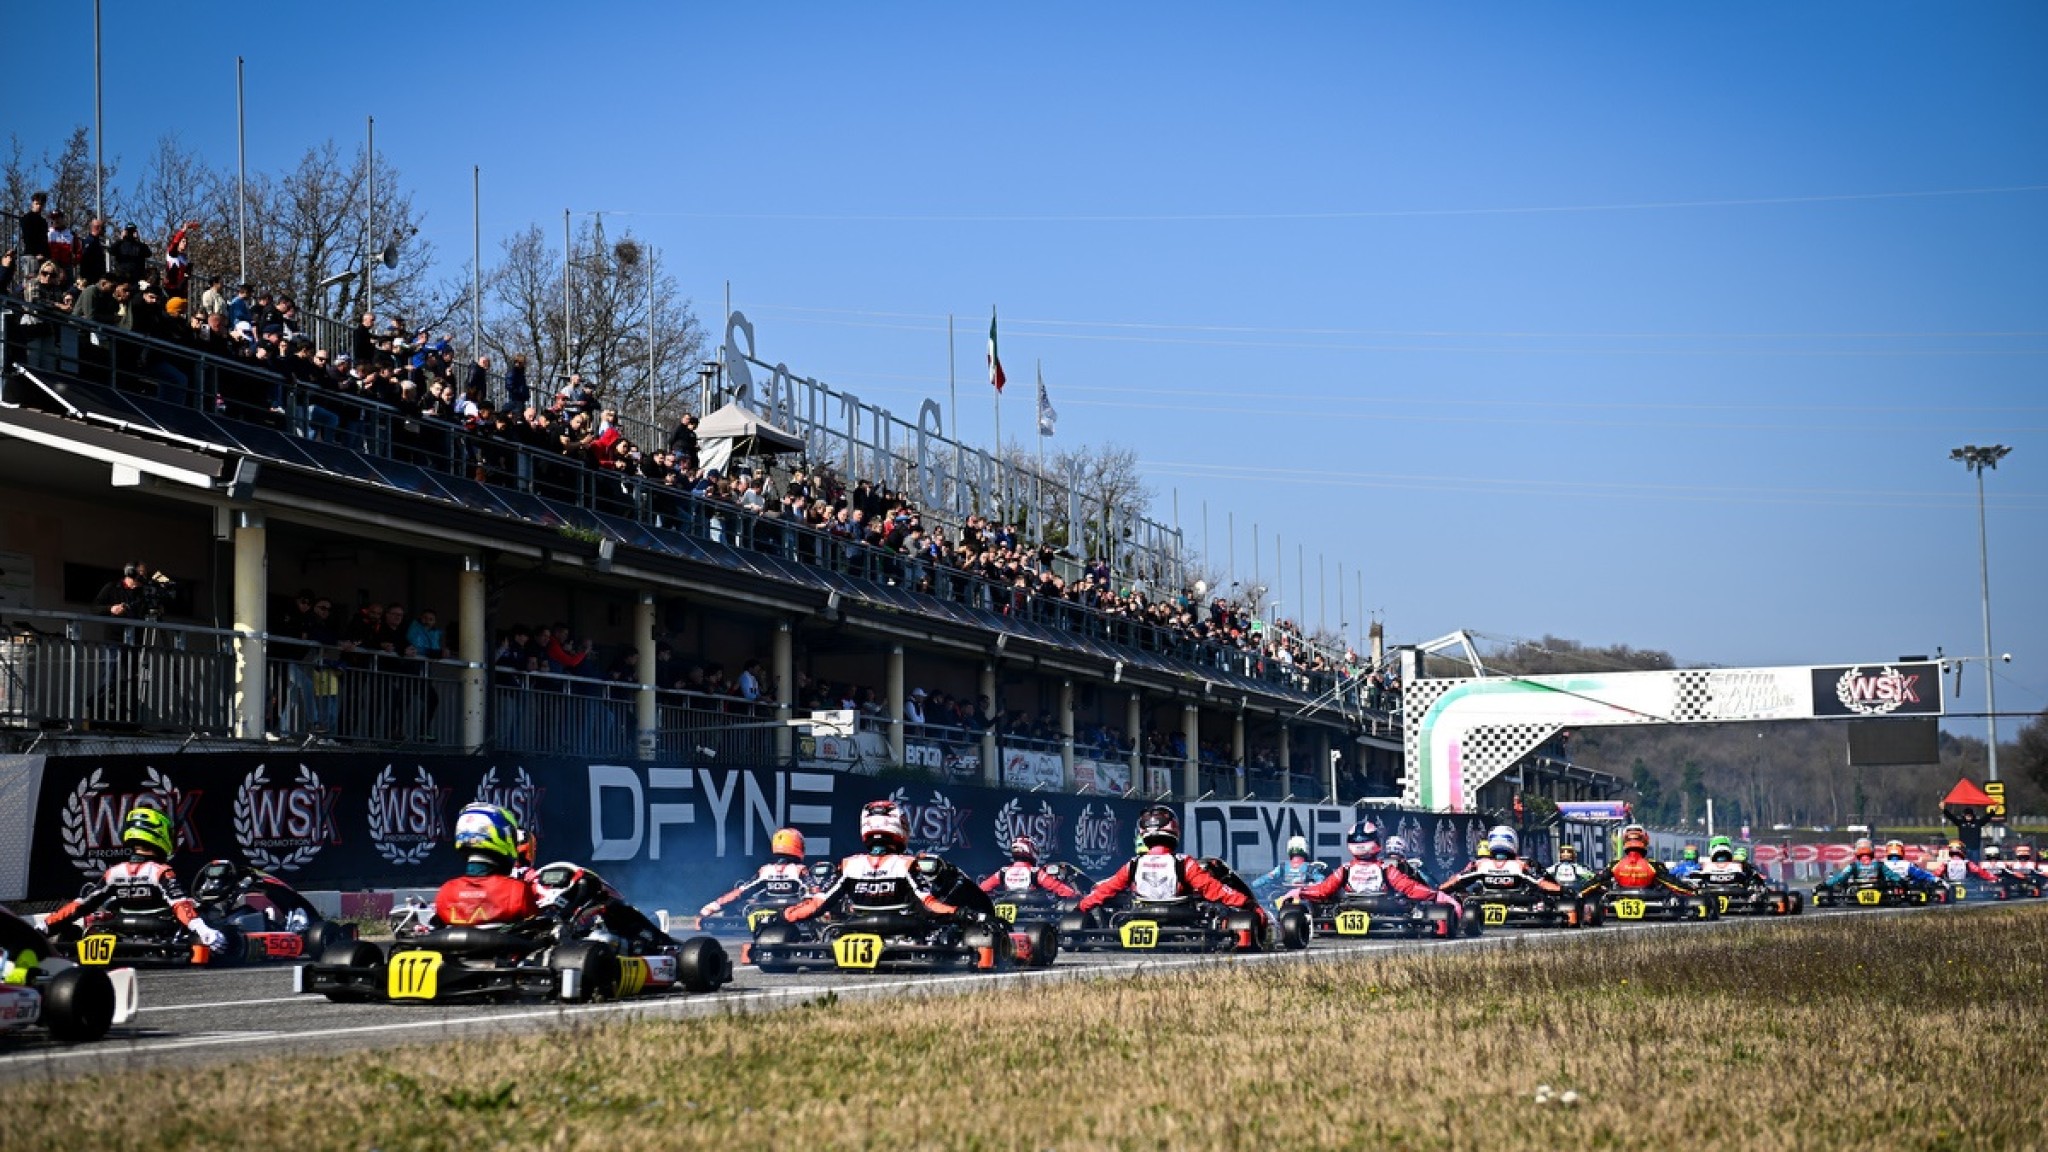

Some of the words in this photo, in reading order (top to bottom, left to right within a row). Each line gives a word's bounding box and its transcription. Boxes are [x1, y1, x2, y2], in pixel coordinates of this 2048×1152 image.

[1847, 675, 1920, 704] WSK
[250, 787, 342, 844] WSK
[379, 787, 451, 840] WSK
[254, 838, 311, 848] PROMOTION
[1621, 901, 1641, 916] 153
[1341, 914, 1365, 931] 133
[1129, 925, 1154, 945] 155
[84, 938, 110, 961] 105
[842, 938, 875, 964] 113
[398, 958, 433, 993] 117
